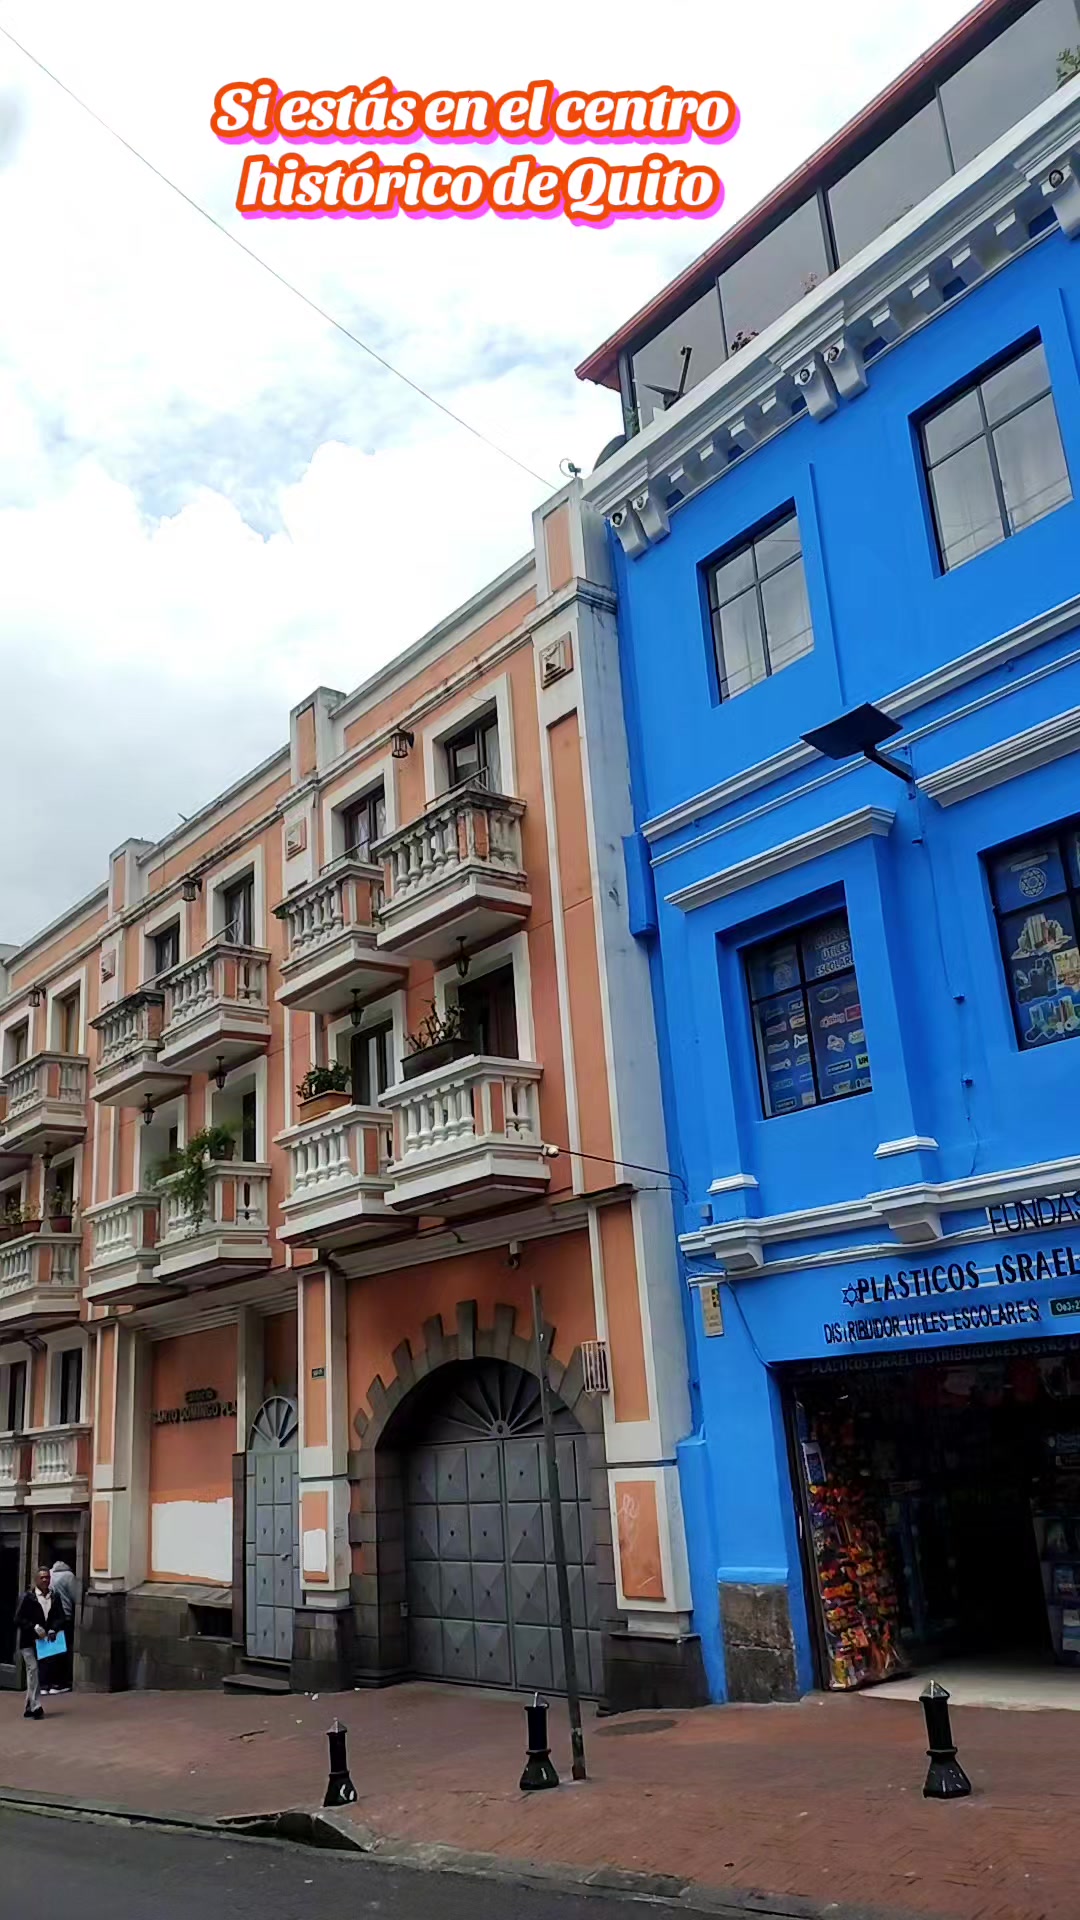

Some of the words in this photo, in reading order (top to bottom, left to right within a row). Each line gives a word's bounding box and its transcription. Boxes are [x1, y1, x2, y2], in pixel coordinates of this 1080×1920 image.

[857, 1261, 979, 1303] PLASTICOS
[994, 1246, 1080, 1284] ISRAEL
[904, 1311, 949, 1336] UTILES
[952, 1298, 1041, 1331] ESCOLARES
